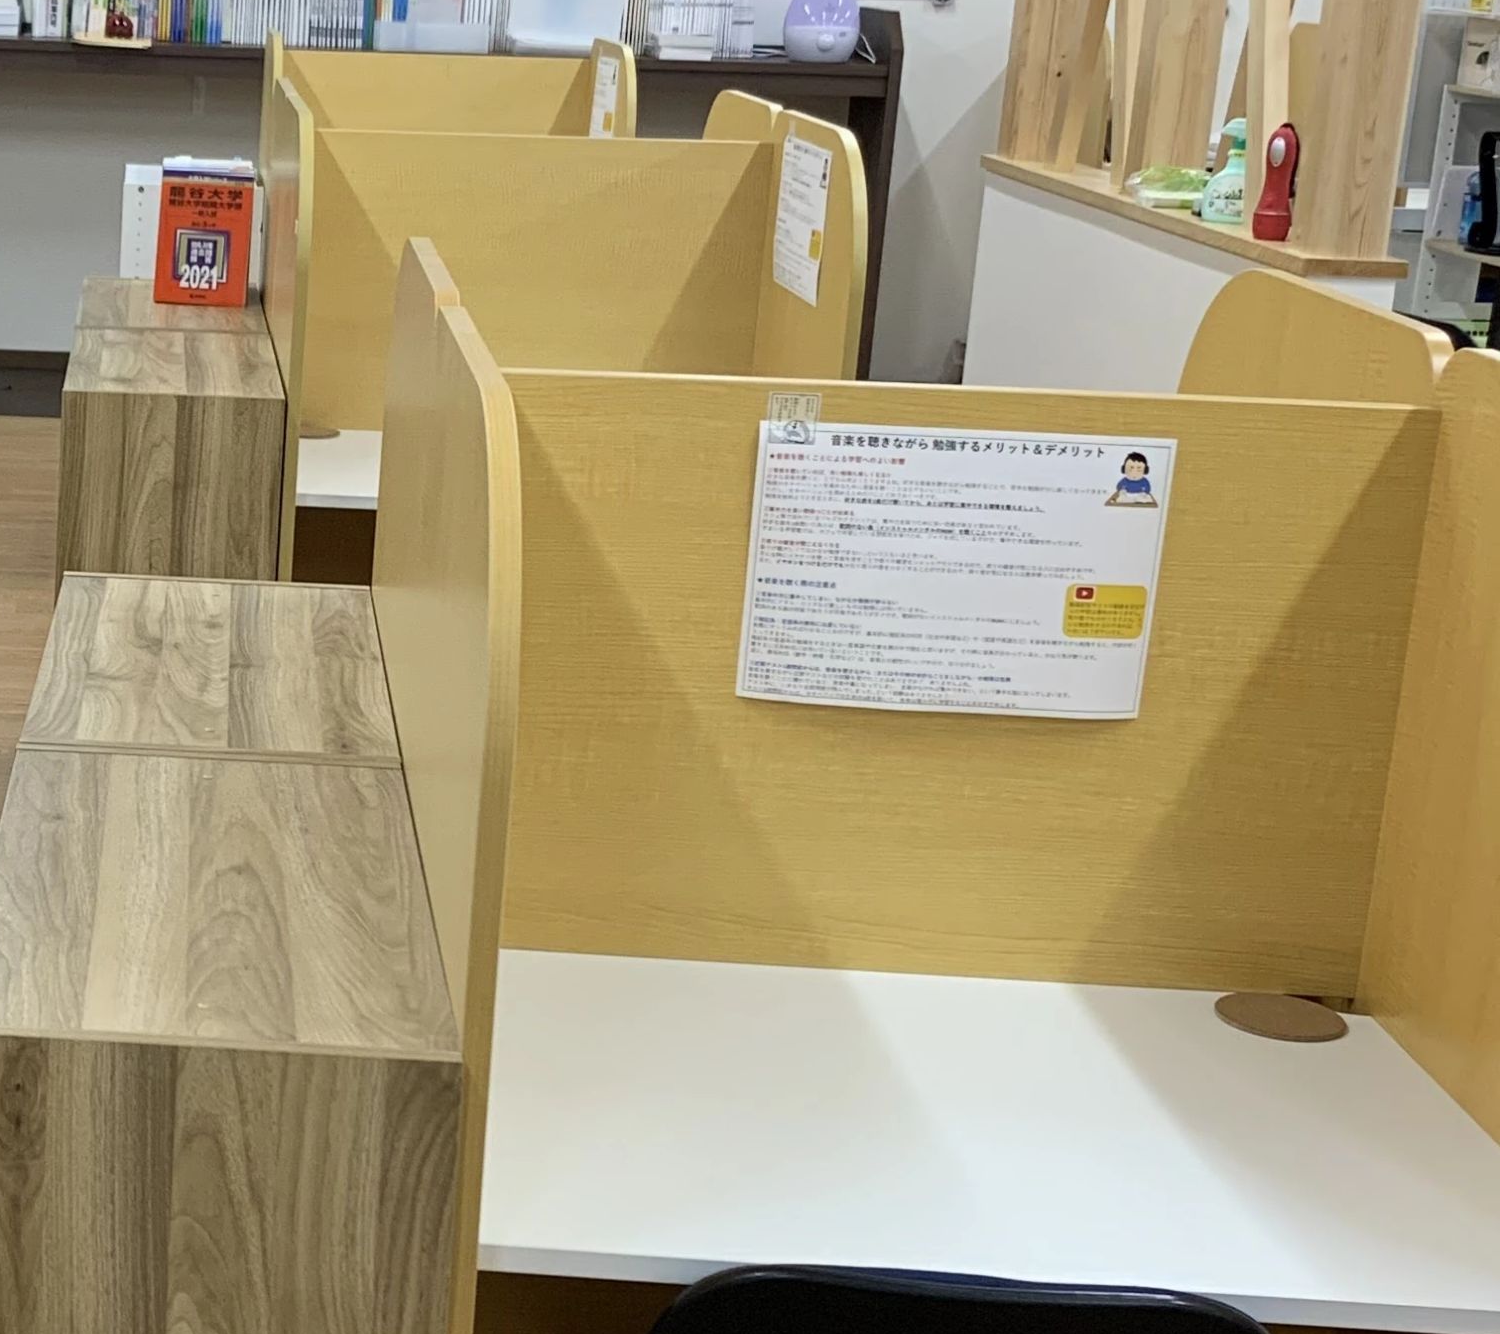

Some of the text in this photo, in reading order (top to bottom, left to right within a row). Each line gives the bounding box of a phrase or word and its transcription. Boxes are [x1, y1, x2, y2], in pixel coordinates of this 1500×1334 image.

[179, 264, 218, 291] 2021
[831, 434, 929, 451] 音楽を聴きながら
